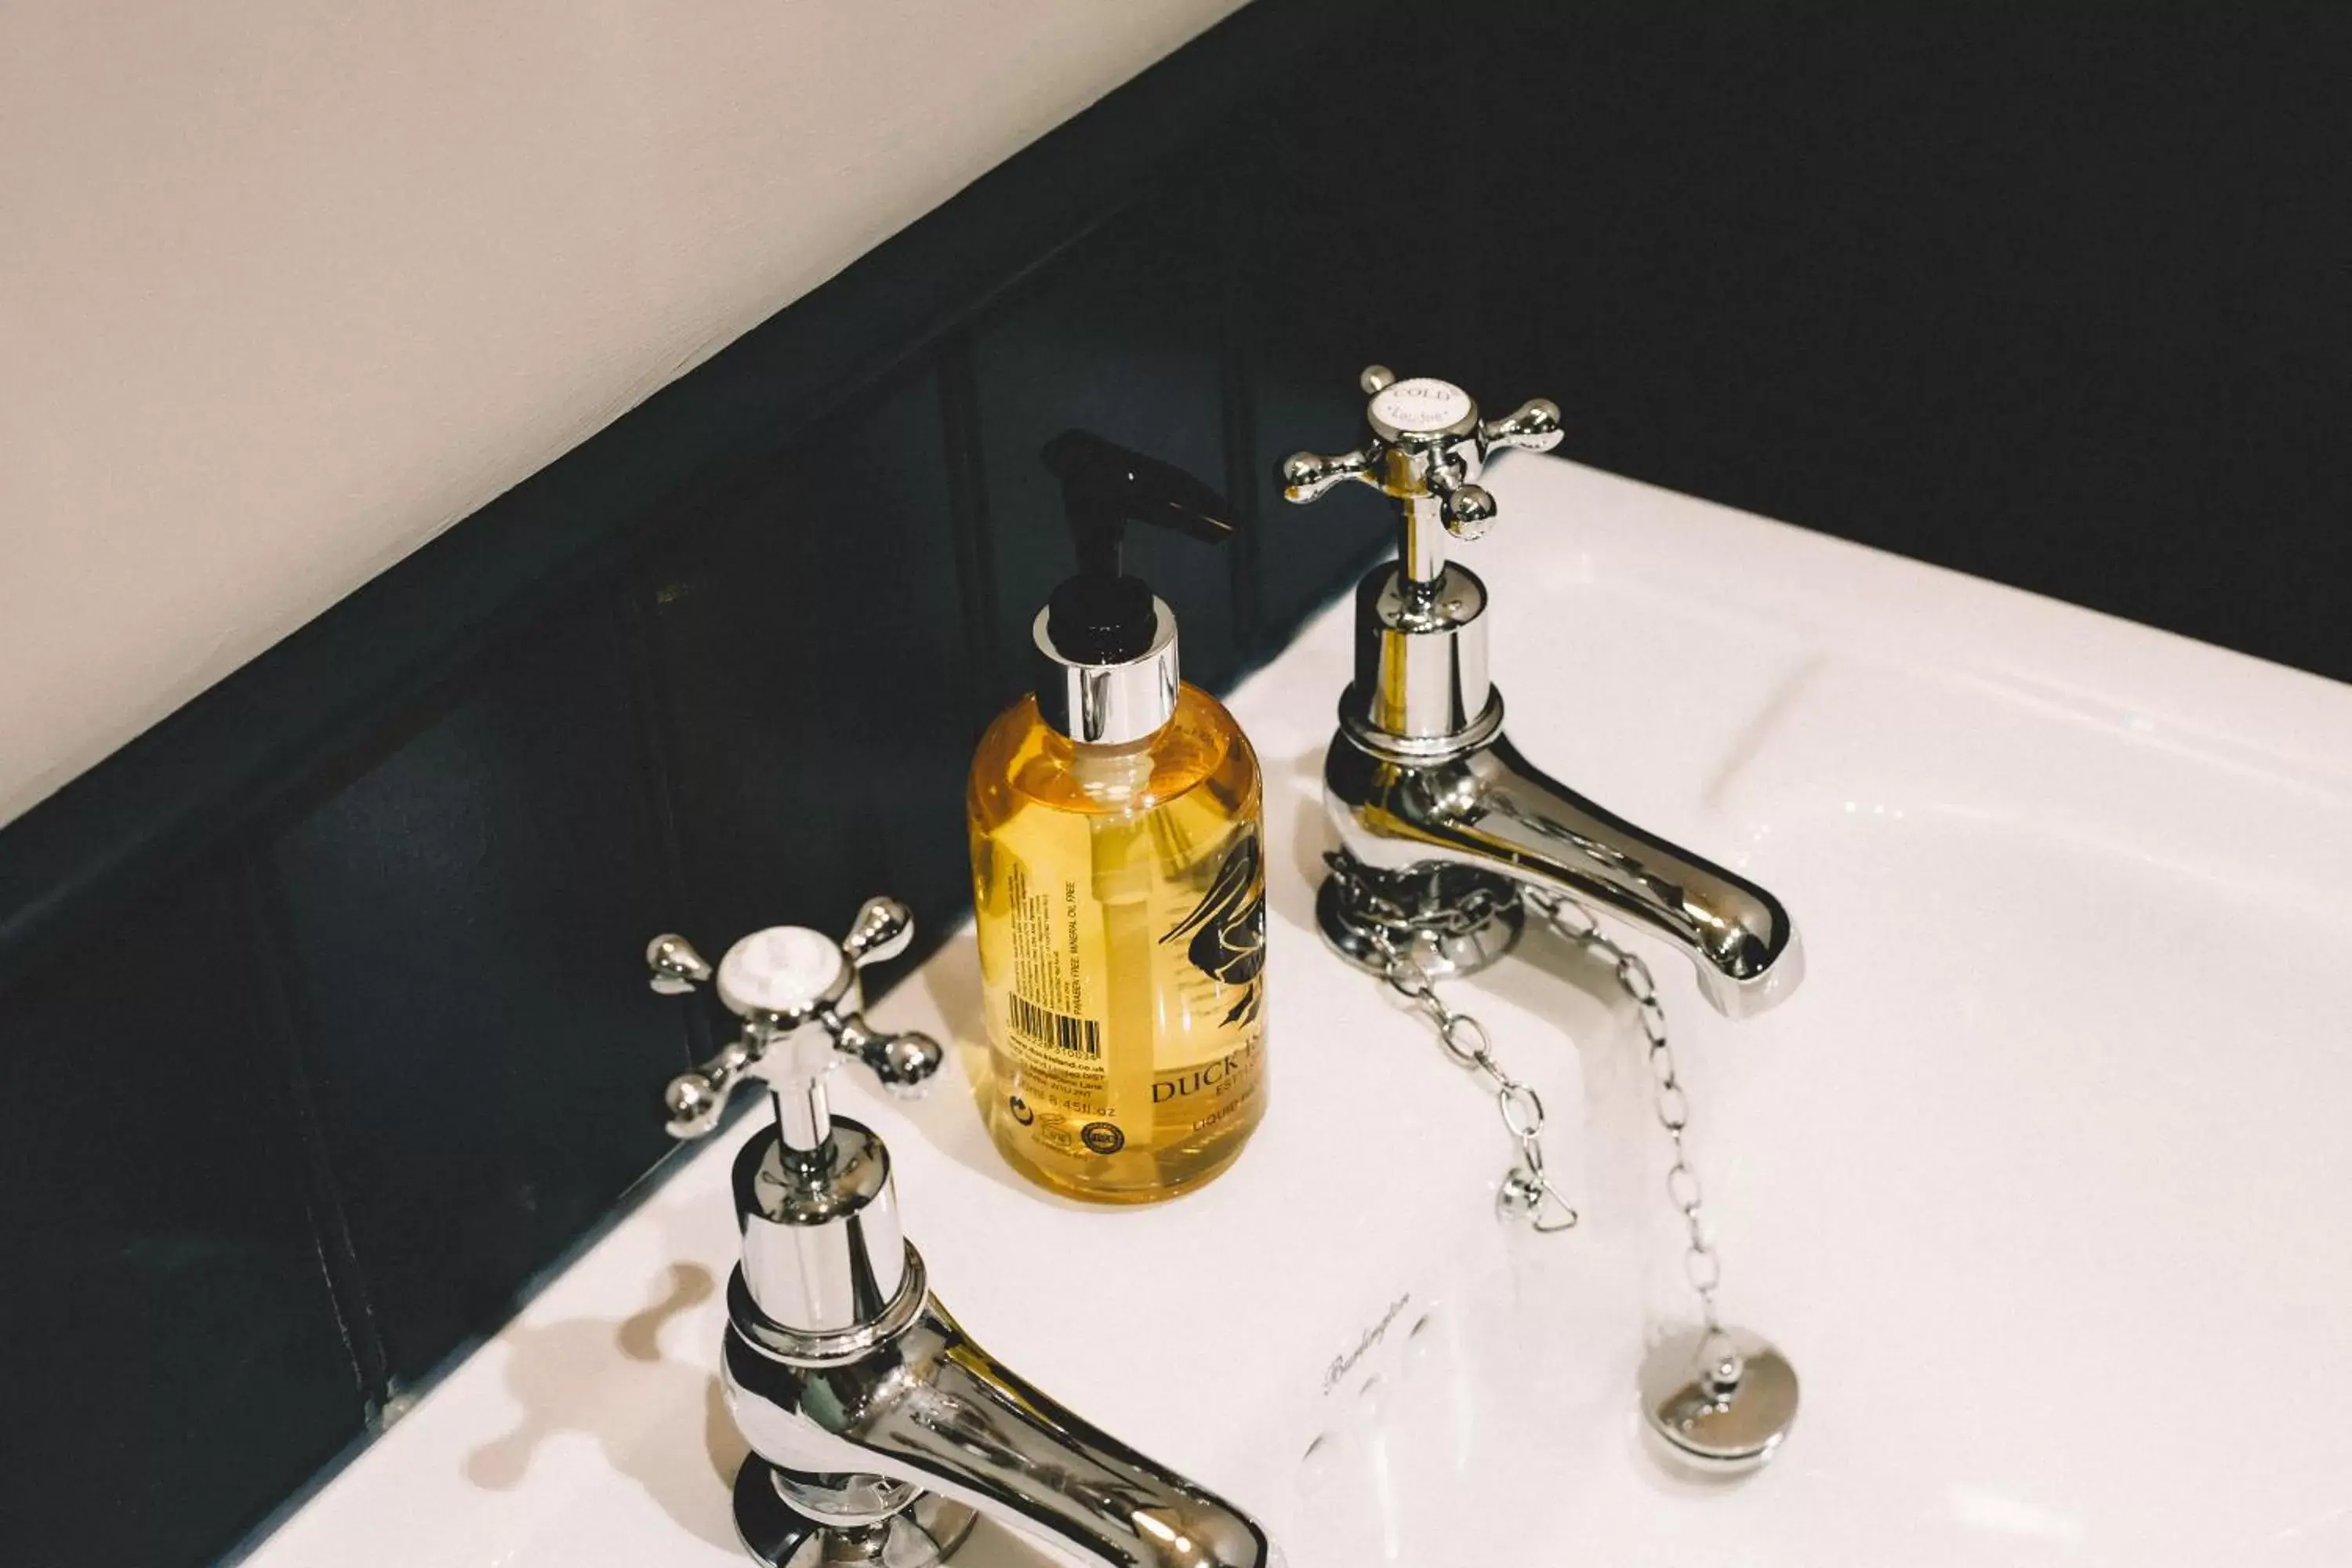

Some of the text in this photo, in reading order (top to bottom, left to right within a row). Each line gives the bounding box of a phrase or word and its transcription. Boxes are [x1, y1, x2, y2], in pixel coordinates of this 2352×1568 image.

[1393, 387, 1450, 401] COLD
[1065, 880, 1076, 902] FREE
[1067, 904, 1077, 918] OIL
[1069, 921, 1079, 954] MINERAL
[1152, 1055, 1239, 1104] DUCK
